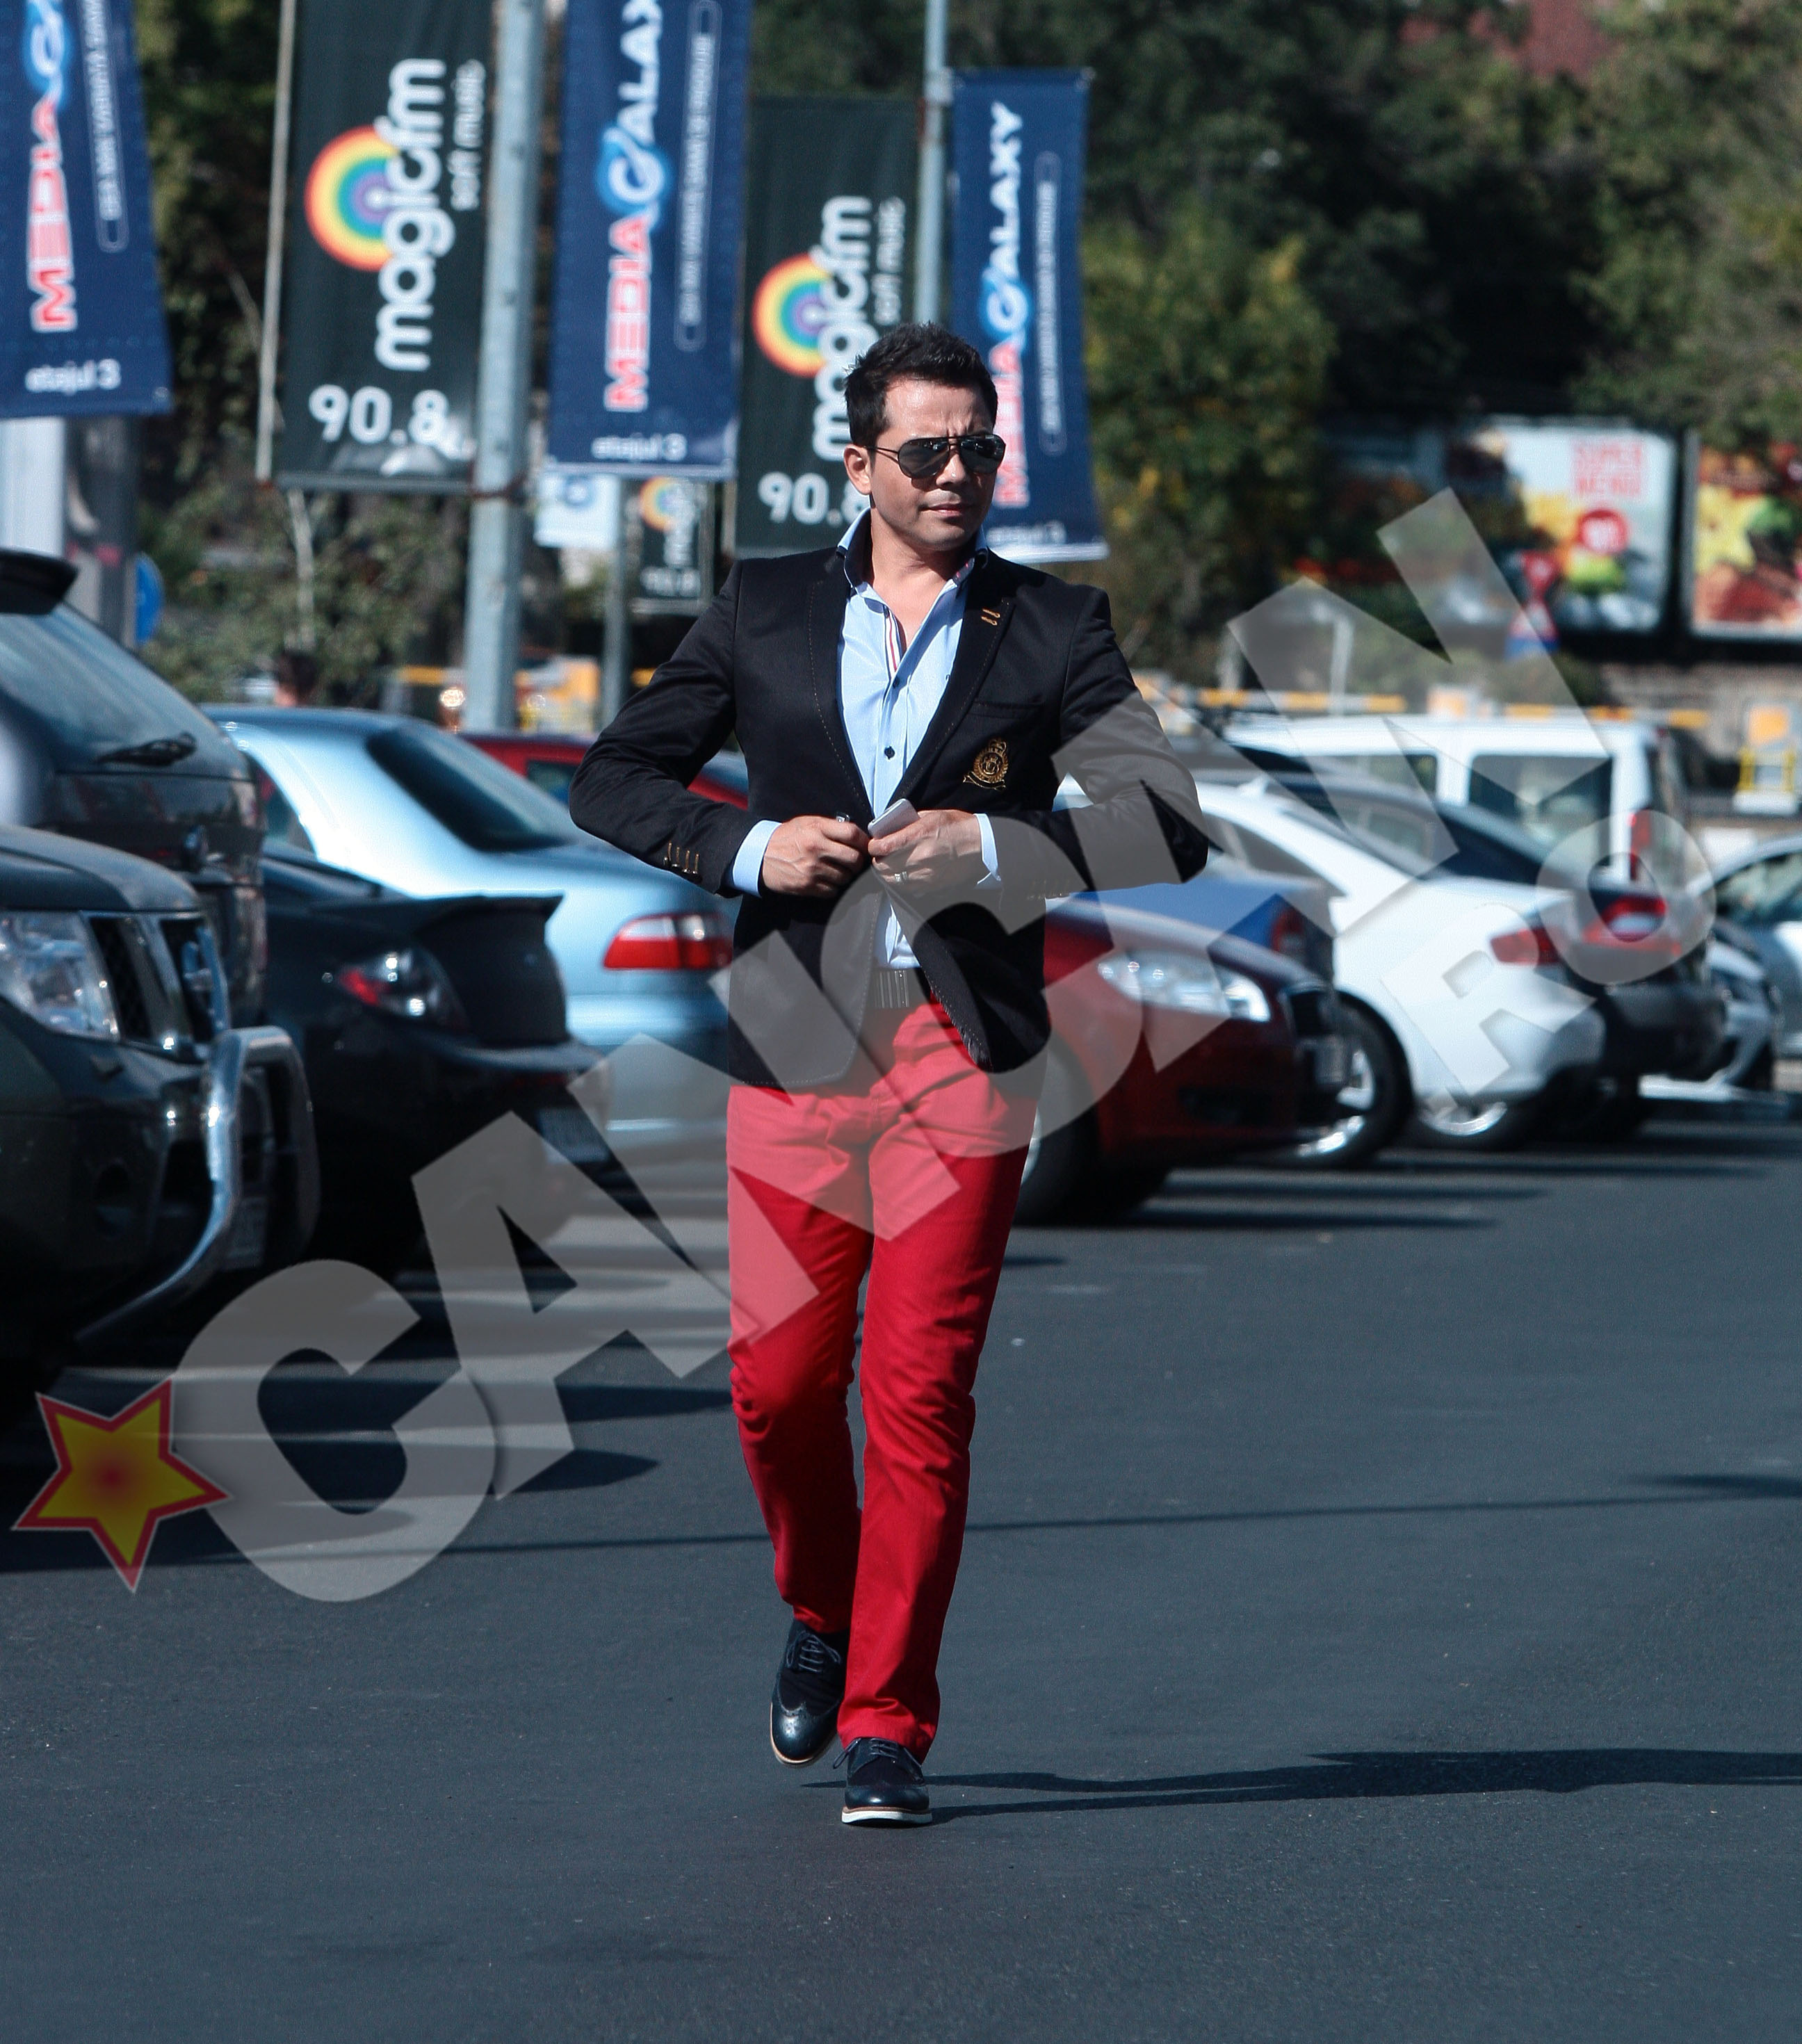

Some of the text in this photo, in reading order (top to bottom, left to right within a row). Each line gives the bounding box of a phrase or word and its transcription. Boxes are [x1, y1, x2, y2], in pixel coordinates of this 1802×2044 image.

[365, 58, 455, 371] magicfm
[603, 214, 654, 412] MEDIA
[981, 101, 1029, 336] GALAXY
